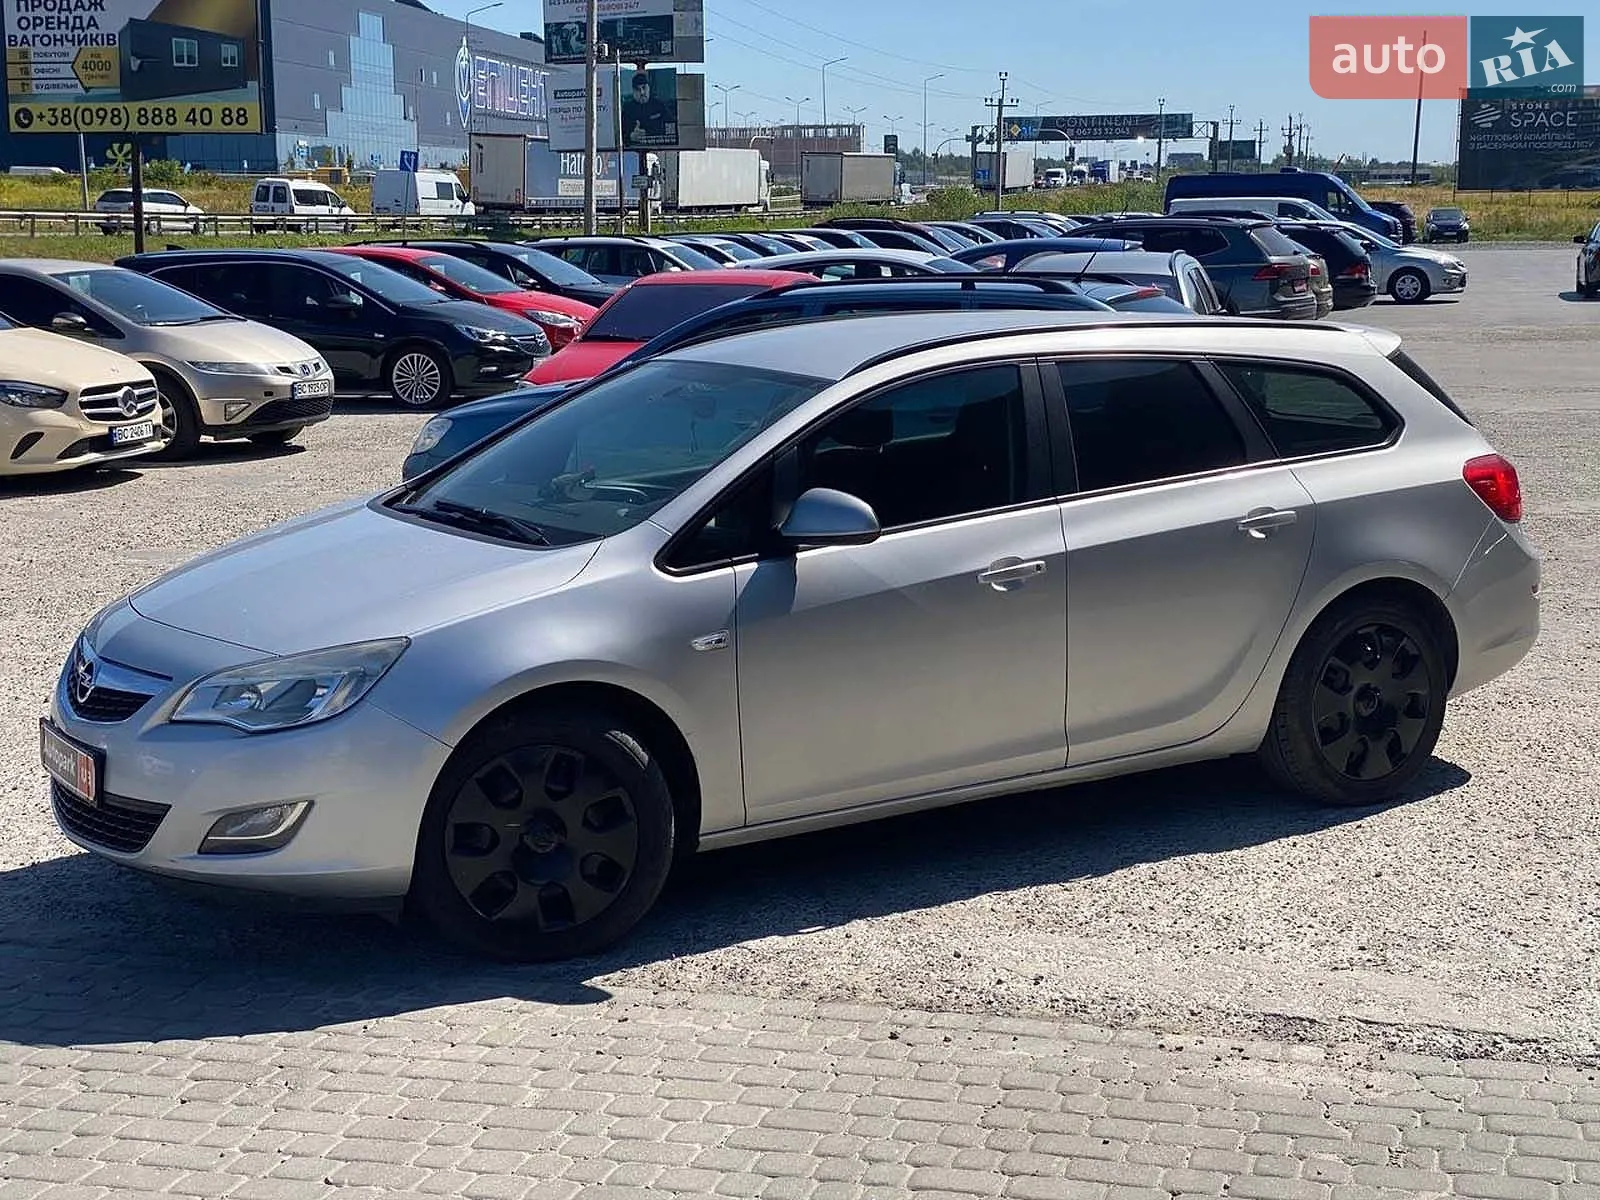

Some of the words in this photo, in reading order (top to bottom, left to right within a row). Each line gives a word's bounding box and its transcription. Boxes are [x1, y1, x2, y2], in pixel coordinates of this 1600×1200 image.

[16, 0, 106, 14] ПРОДАЖ
[17, 15, 100, 33] ОРЕНДА
[7, 33, 117, 47] ВАГОНЧИКІВ
[81, 60, 112, 72] 4000
[37, 105, 130, 131] +38(098)
[137, 107, 177, 126] 888
[185, 107, 213, 126] 40
[221, 107, 249, 126] 88
[1056, 116, 1138, 128] CONTINENT
[1510, 111, 1578, 128] SPACE
